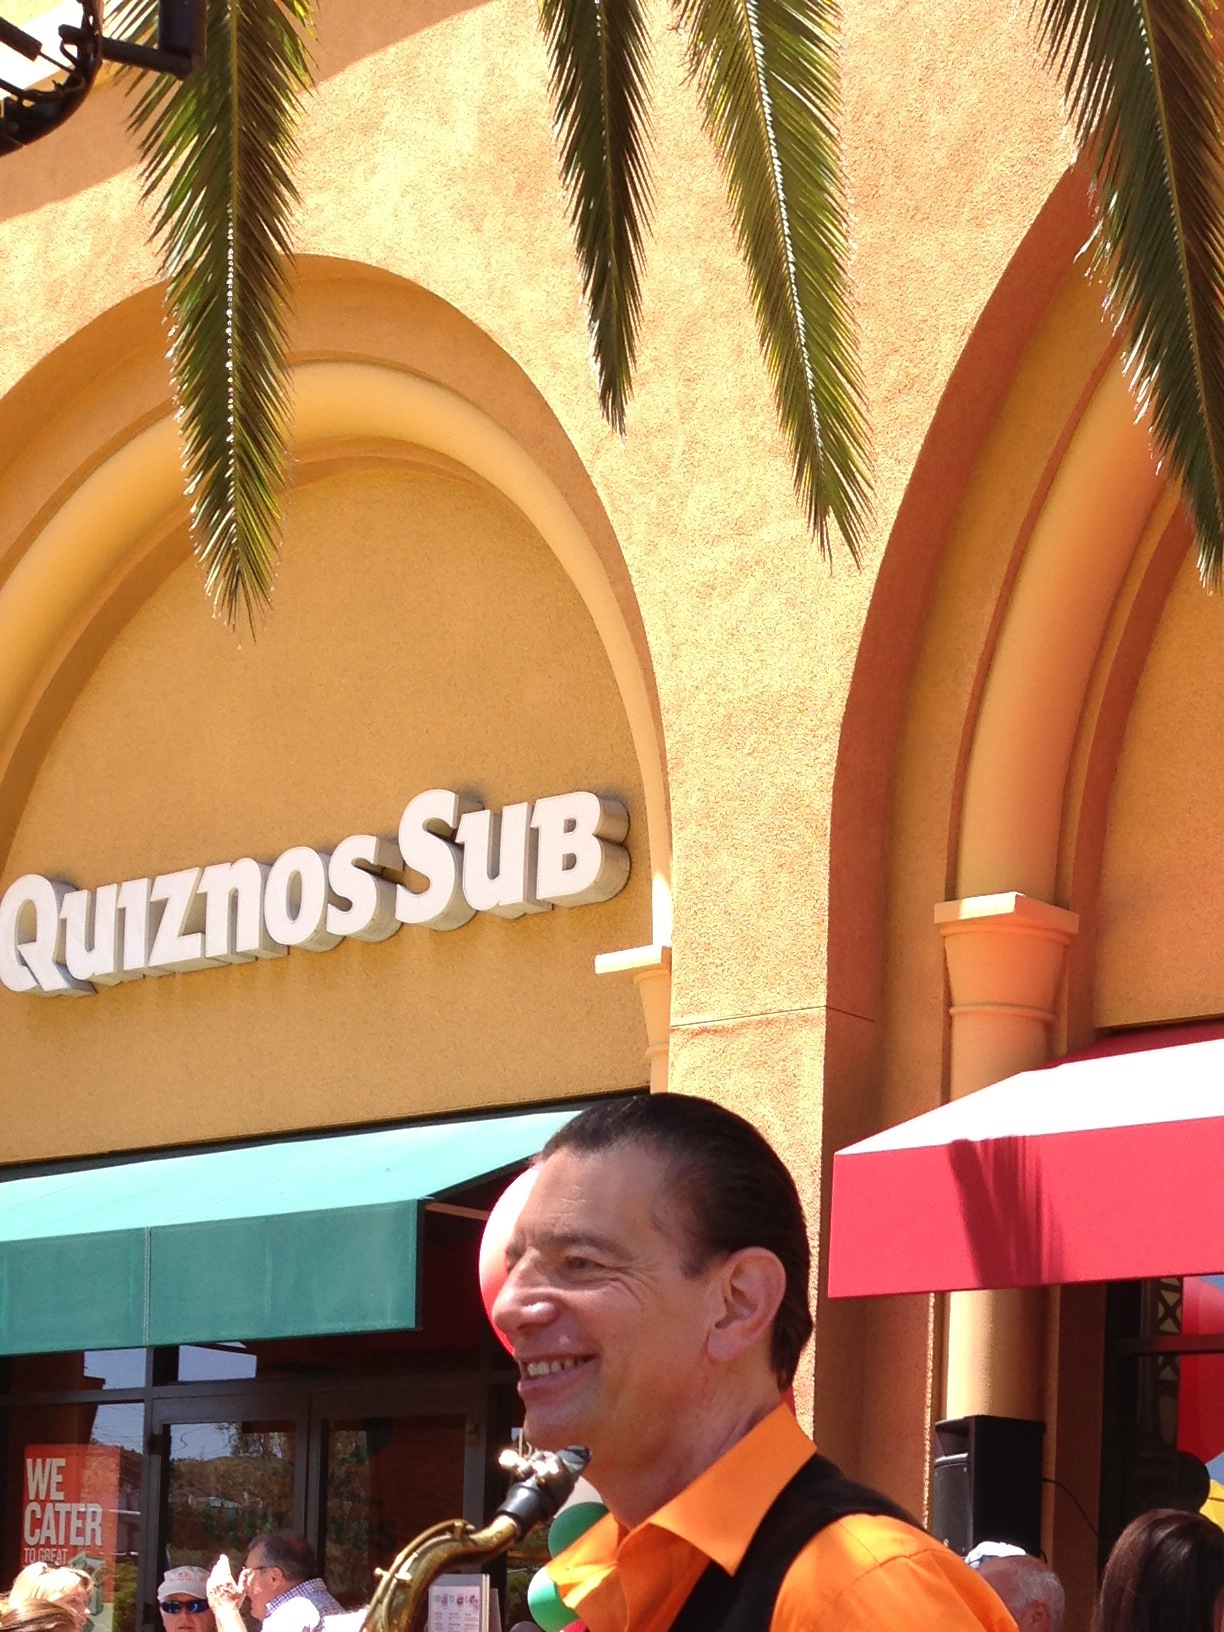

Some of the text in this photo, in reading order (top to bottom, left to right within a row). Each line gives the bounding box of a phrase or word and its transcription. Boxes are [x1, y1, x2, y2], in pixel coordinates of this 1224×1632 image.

[26, 1457, 66, 1501] WE
[24, 1502, 102, 1547] CATER
[24, 1547, 37, 1564] TO
